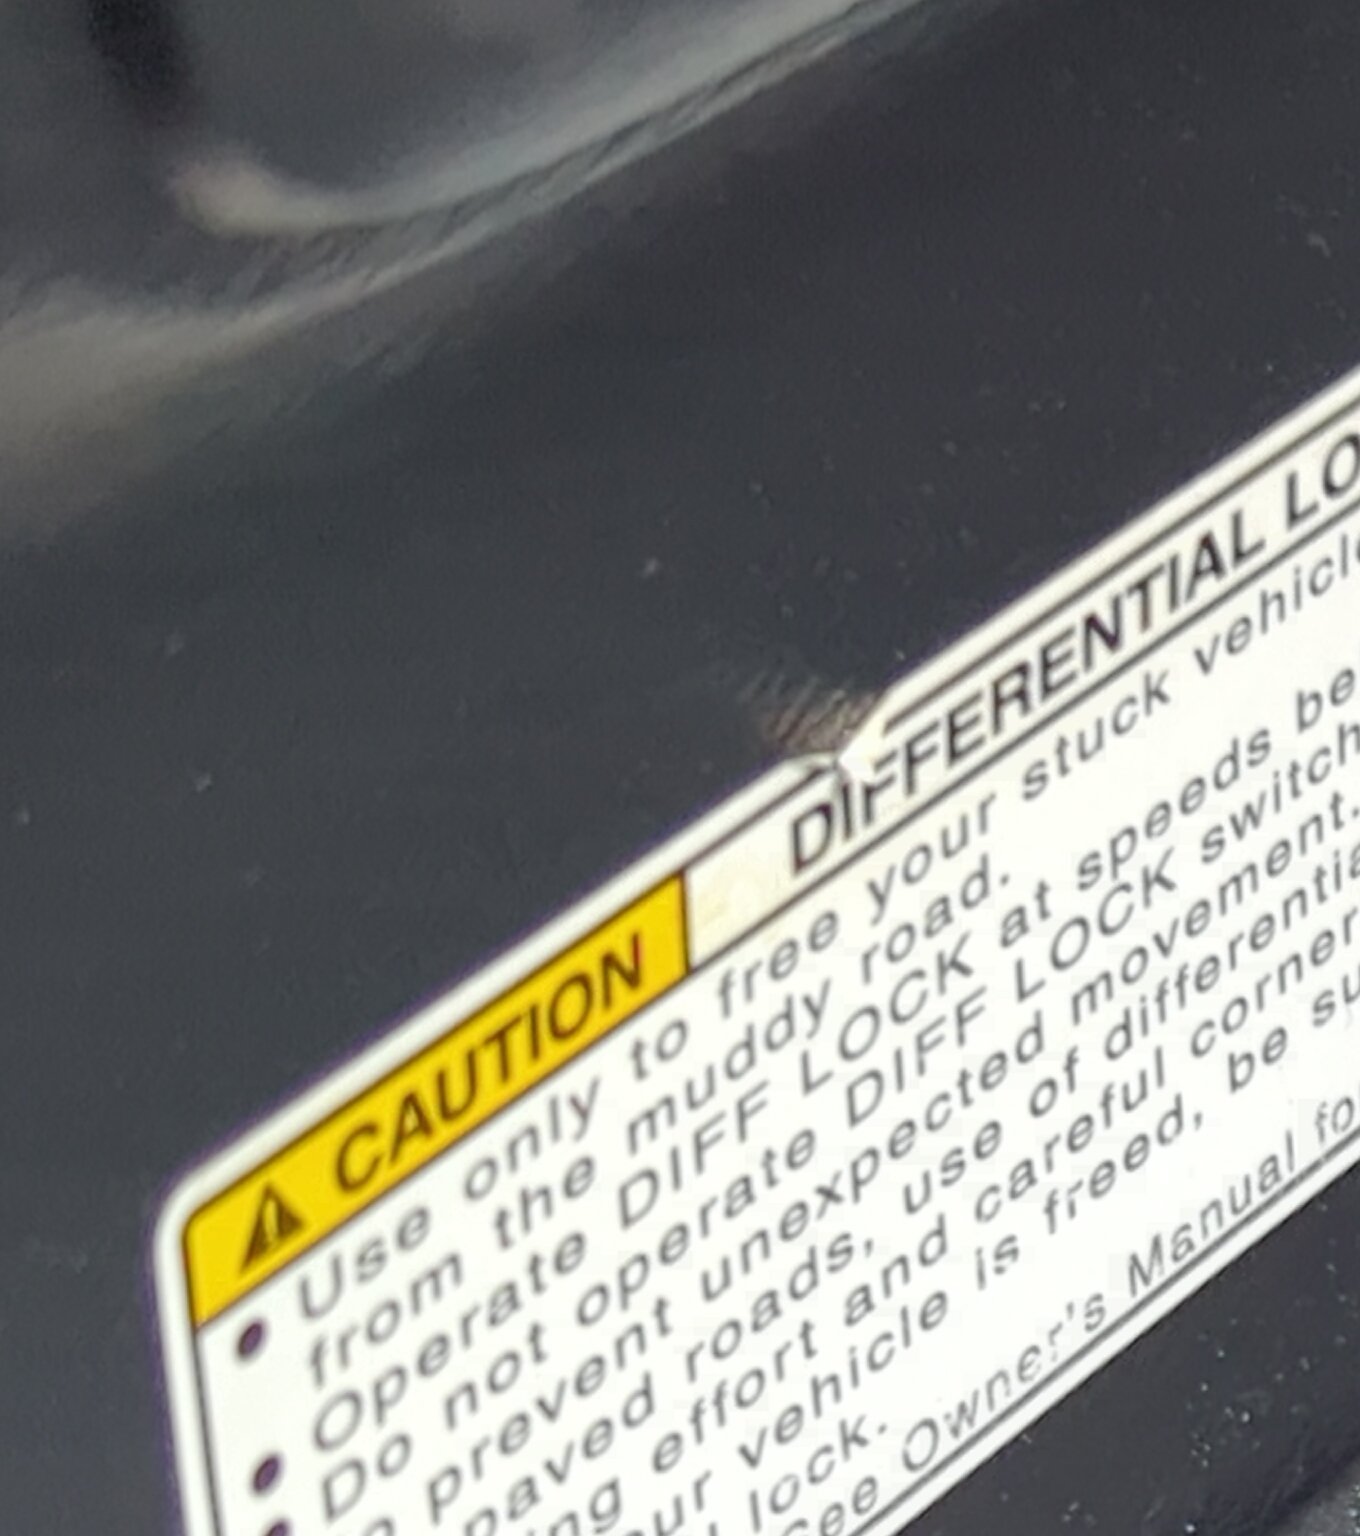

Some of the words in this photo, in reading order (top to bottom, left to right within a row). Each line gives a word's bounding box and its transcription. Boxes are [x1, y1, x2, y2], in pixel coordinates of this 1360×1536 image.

[788, 507, 1266, 874] DIFFERENTIAL
[296, 1205, 430, 1321] Use
[462, 1077, 599, 1201] only
[629, 1017, 689, 1081] to
[716, 909, 839, 1019] free
[865, 791, 996, 926] your
[1021, 670, 1170, 802] stuck
[307, 1252, 463, 1388] from
[492, 1154, 595, 1250] the
[626, 978, 830, 1155] muddy
[860, 852, 1009, 985] road.
[311, 1230, 586, 1453] Operate
[616, 1079, 768, 1230] DIFF
[799, 931, 973, 1096] LOCK
[999, 879, 1051, 949] at
[1076, 727, 1271, 892] speeds
[319, 1432, 412, 1523] Do
[443, 1321, 547, 1430] not
[574, 1128, 816, 1327] operate
[845, 985, 986, 1128] DIFF
[1014, 846, 1176, 1003] LOCK
[334, 932, 642, 1194] CAUTION
[425, 1296, 672, 1525] prevent
[699, 1009, 1044, 1302] unexpected
[1070, 790, 1360, 1026] movement.
[650, 1319, 817, 1474] effort
[843, 1212, 948, 1327] and
[973, 1045, 1165, 1223] careful
[684, 1231, 873, 1383] roads,
[902, 1119, 1002, 1215] use
[1027, 1045, 1079, 1118] of
[737, 1290, 948, 1469] vehicle
[974, 1234, 1020, 1289] is
[1042, 1092, 1202, 1234] freed,
[1227, 1025, 1288, 1093] be
[901, 1292, 1105, 1473] Owner's
[1127, 1130, 1294, 1297] Manual
[748, 1415, 887, 1533] lock.
